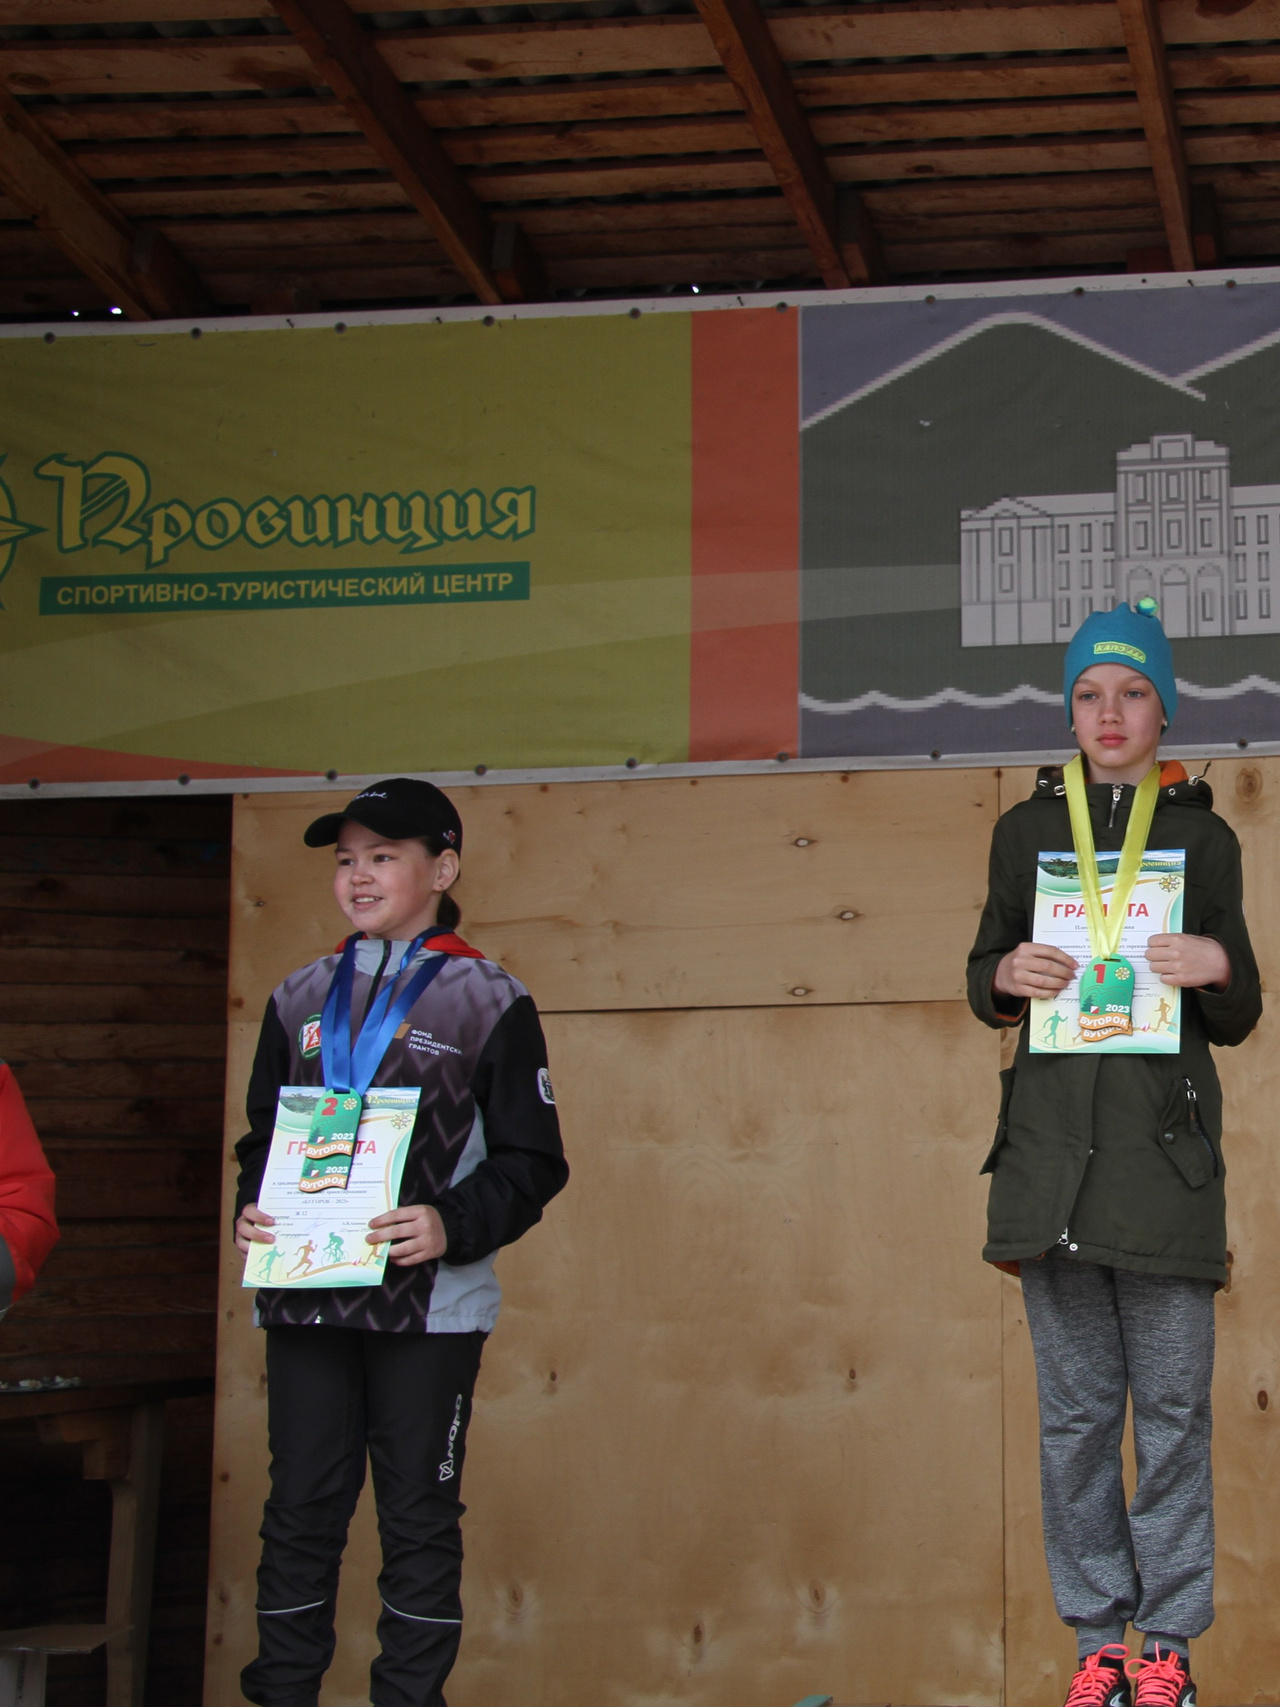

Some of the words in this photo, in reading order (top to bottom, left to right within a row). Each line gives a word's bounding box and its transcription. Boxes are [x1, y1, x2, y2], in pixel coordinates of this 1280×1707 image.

[34, 451, 536, 570] Провинция
[57, 573, 425, 606] СПОРТИВНО-ТУРИСТИЧЕСКИЙ
[433, 572, 514, 596] ЦЕНТР
[1053, 903, 1149, 918] ГРАТА
[1093, 964, 1106, 984] 1
[1105, 1004, 1130, 1014] 2023
[1080, 1016, 1129, 1027] БУГОРОК
[411, 1029, 433, 1040] ФОНД
[408, 1043, 440, 1056] ГРАНТОВ
[322, 1097, 338, 1116] 2
[287, 1140, 376, 1155] ГРТА
[307, 1143, 352, 1155] БУГОРОК
[325, 1166, 348, 1174] 2023
[301, 1177, 346, 1189] БУГОРОК
